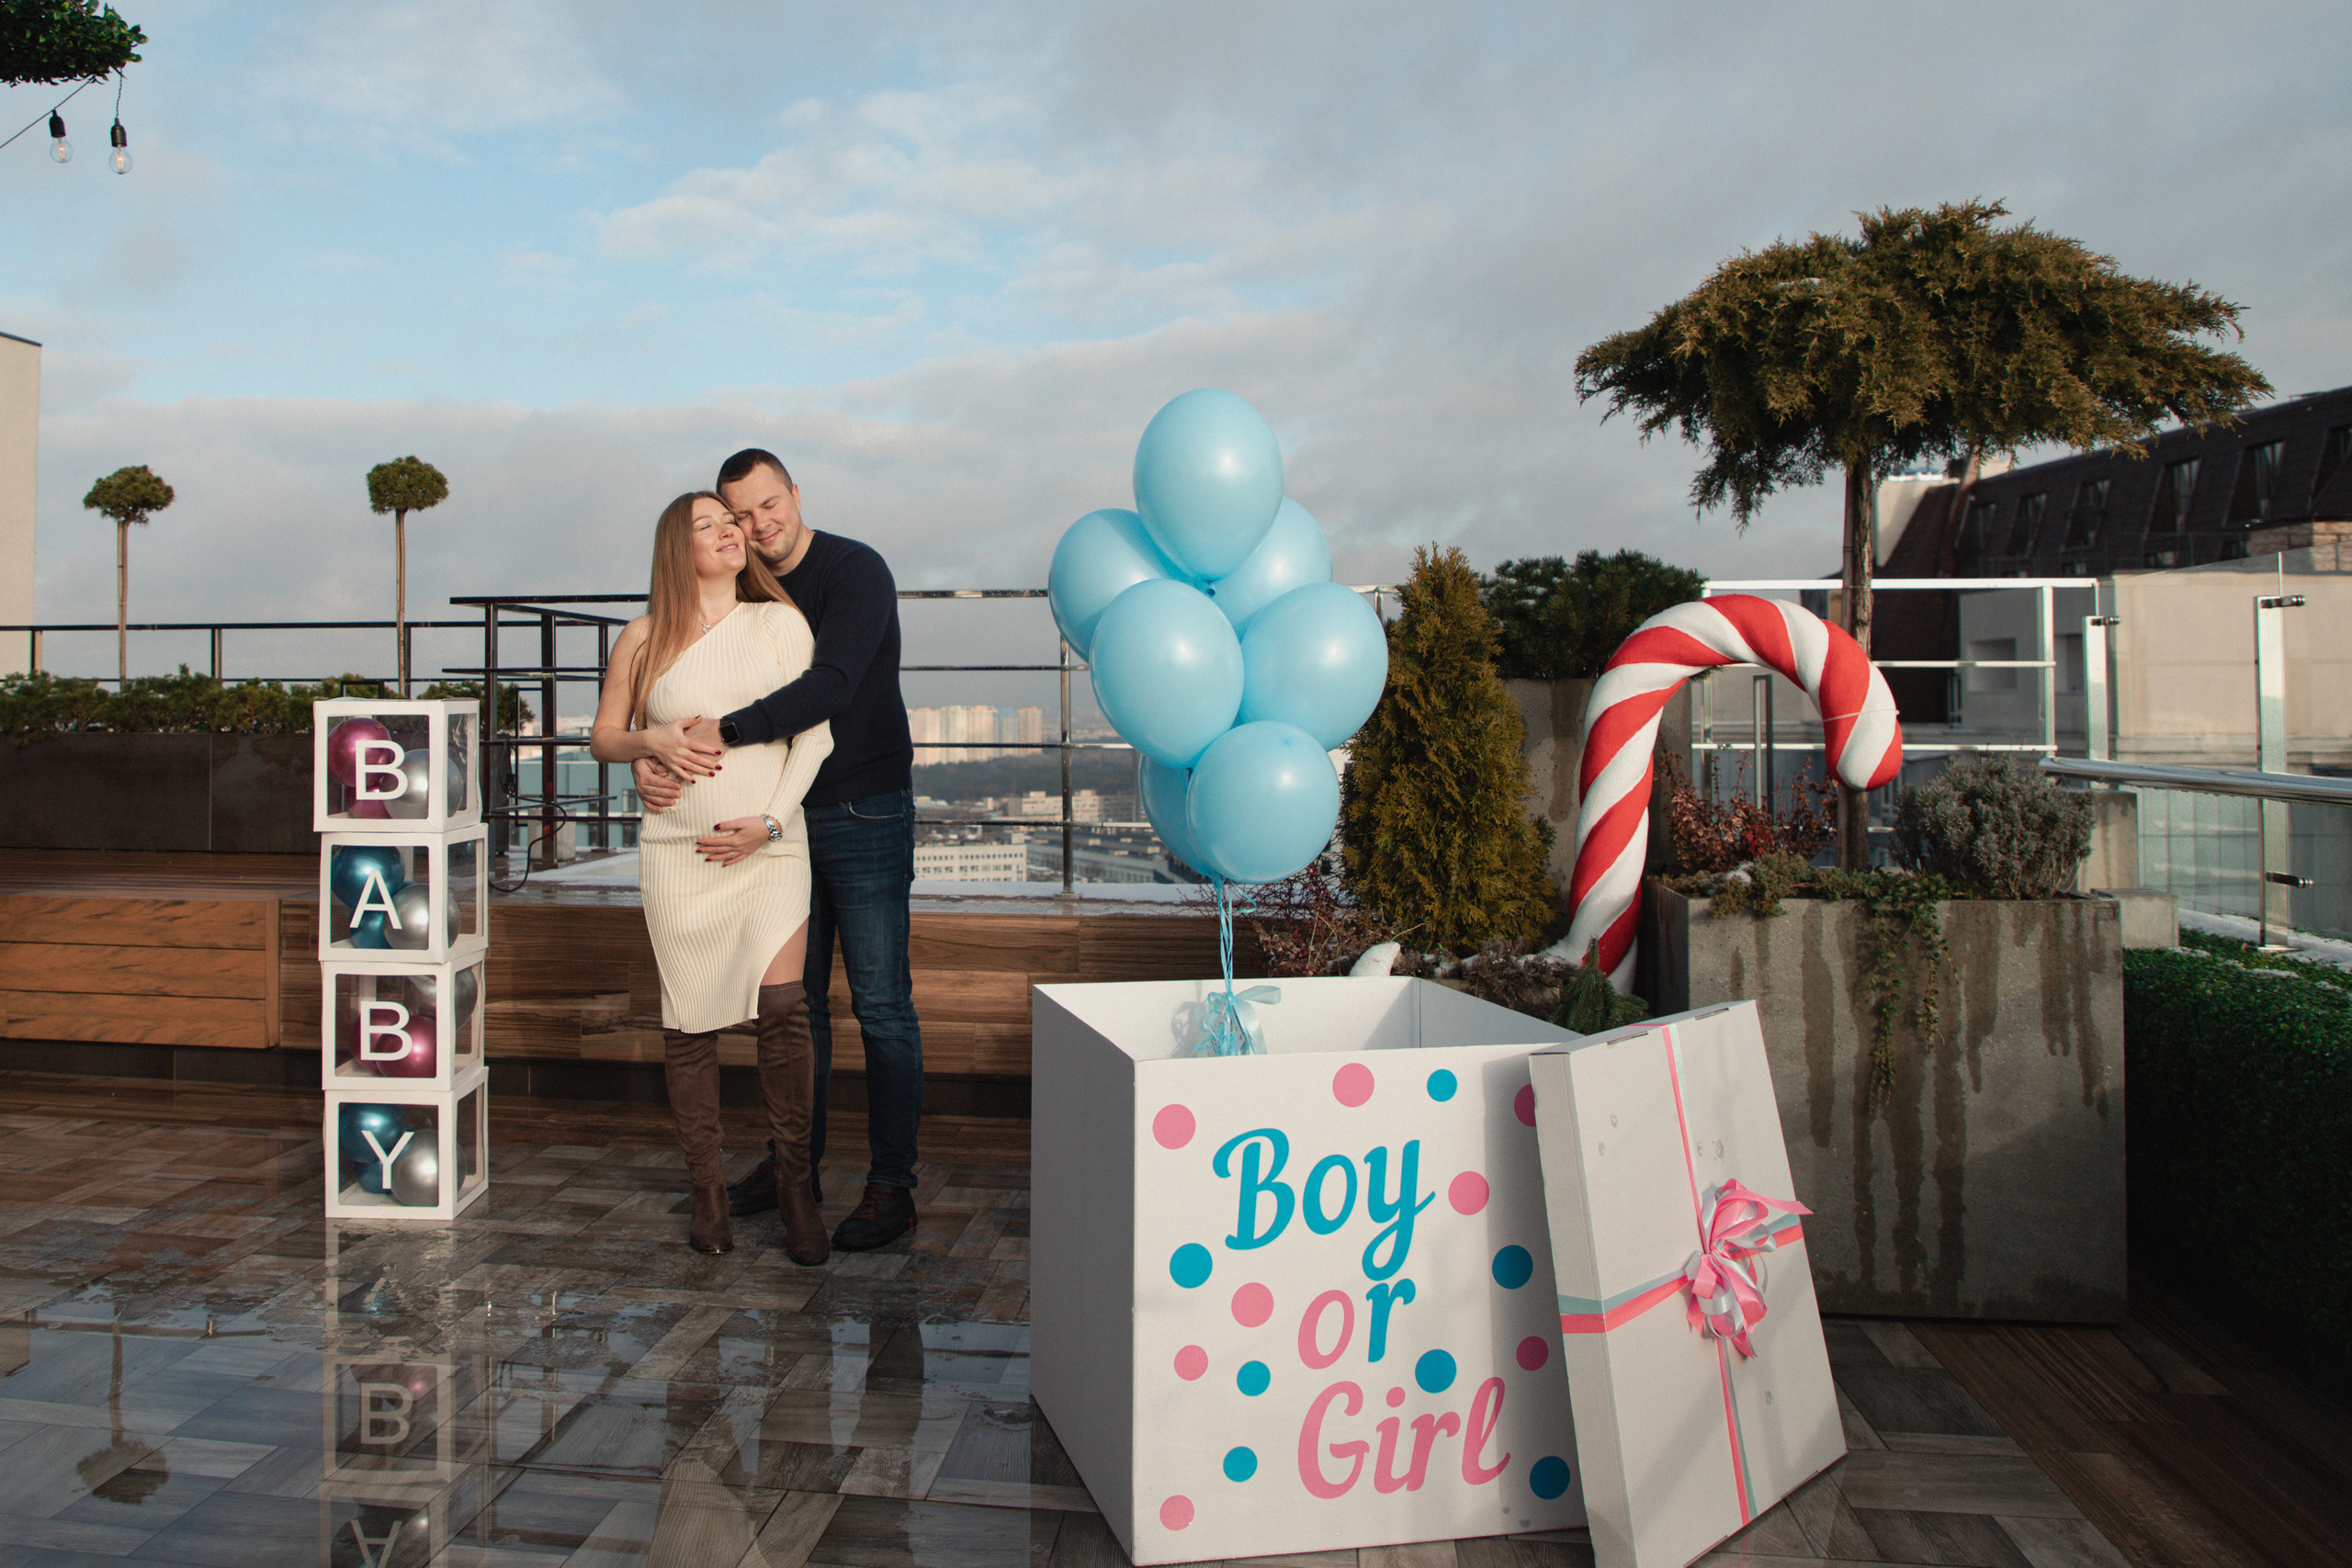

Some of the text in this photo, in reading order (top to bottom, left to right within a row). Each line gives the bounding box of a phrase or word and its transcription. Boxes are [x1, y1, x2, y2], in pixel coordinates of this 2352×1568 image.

[1212, 1128, 1436, 1281] Boy
[1297, 1278, 1416, 1370] or
[1297, 1376, 1511, 1499] Girl
